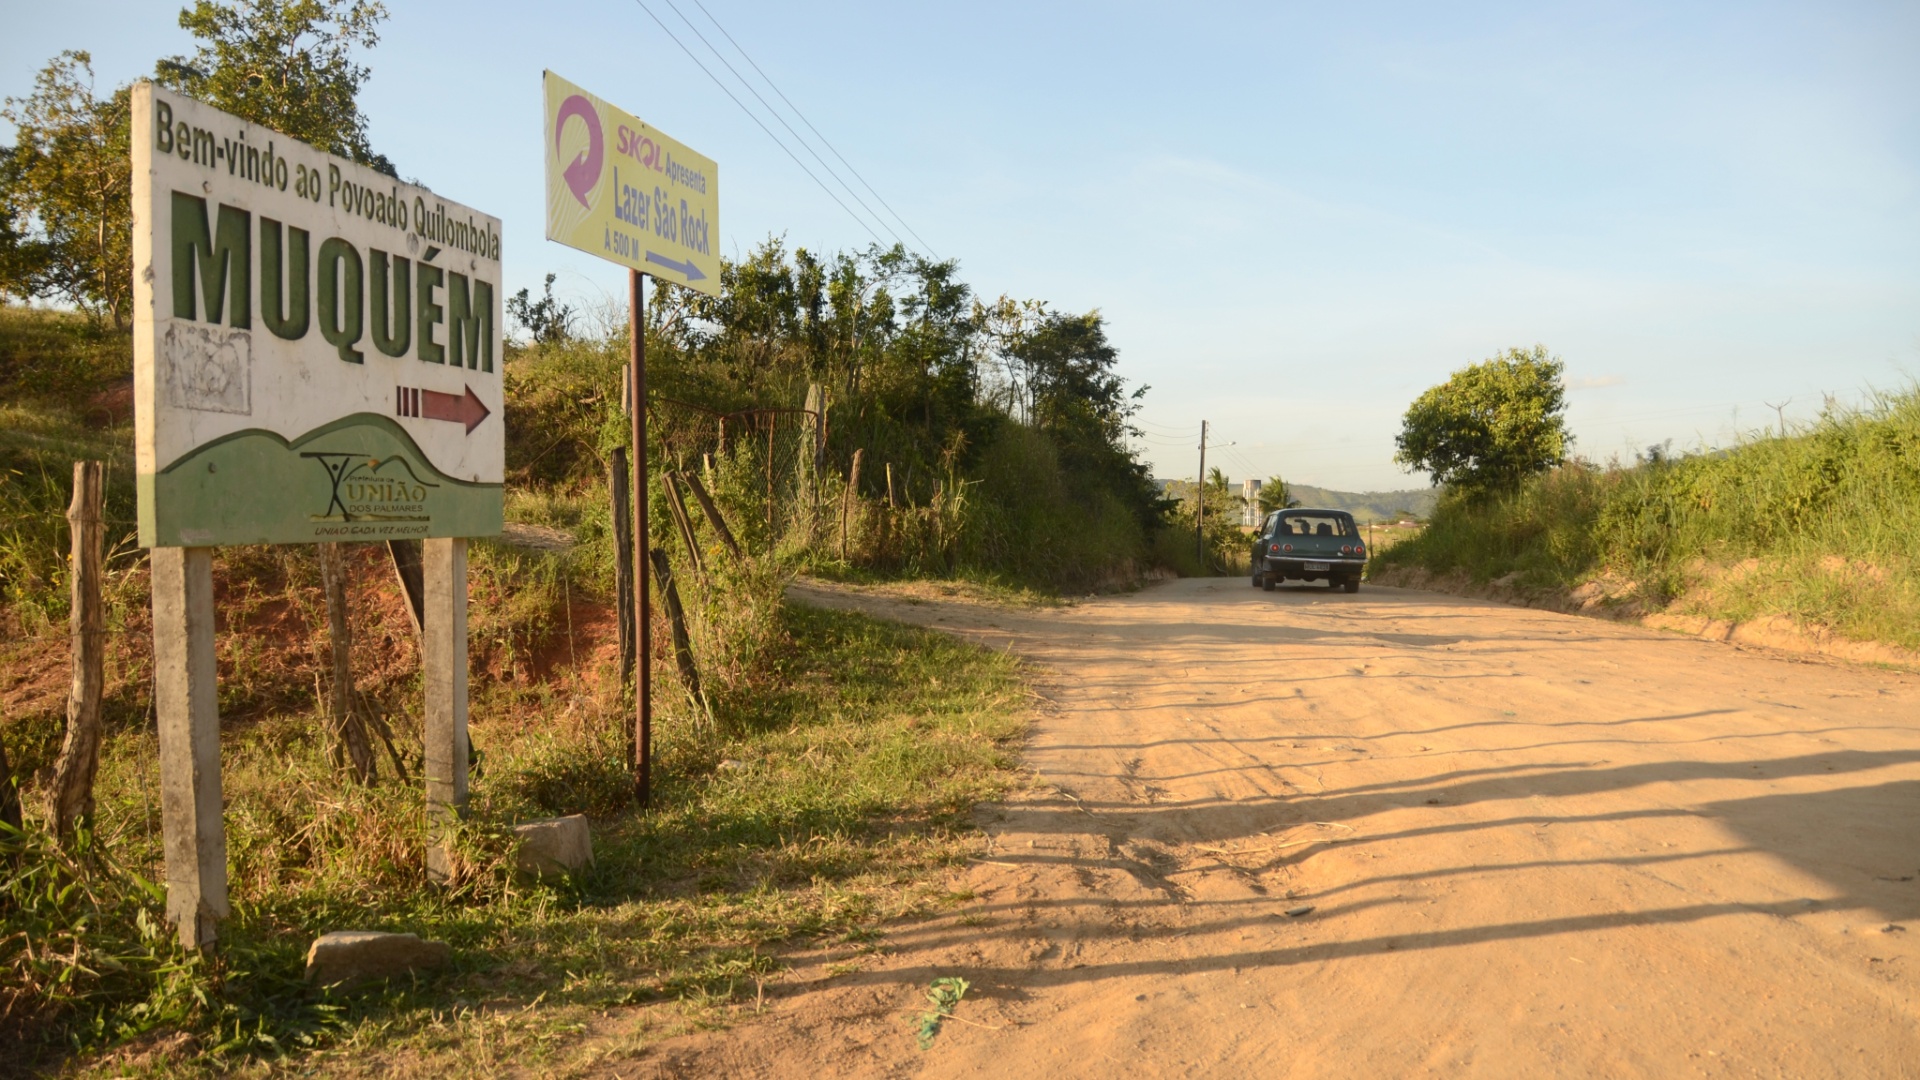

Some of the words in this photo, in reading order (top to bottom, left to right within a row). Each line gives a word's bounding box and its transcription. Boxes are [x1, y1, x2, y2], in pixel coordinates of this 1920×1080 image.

[616, 124, 664, 173] SKOL
[665, 152, 706, 195] Apresenta
[156, 99, 289, 192] Bem-vindo
[295, 163, 321, 203] ao
[328, 163, 408, 232] Povoado
[413, 196, 500, 262] Quilombola
[614, 166, 651, 231] Lazer
[654, 186, 677, 243] São
[680, 199, 710, 256] Rock
[613, 231, 629, 259] 500
[632, 238, 639, 262] M
[171, 190, 494, 374] MUQUÉM
[346, 481, 427, 502] UNIÃO
[349, 475, 384, 483] Prefeitura
[349, 504, 371, 513] DOS
[374, 504, 423, 513] PALMARES
[379, 526, 394, 534] VEZ
[396, 525, 429, 535] MELHOR
